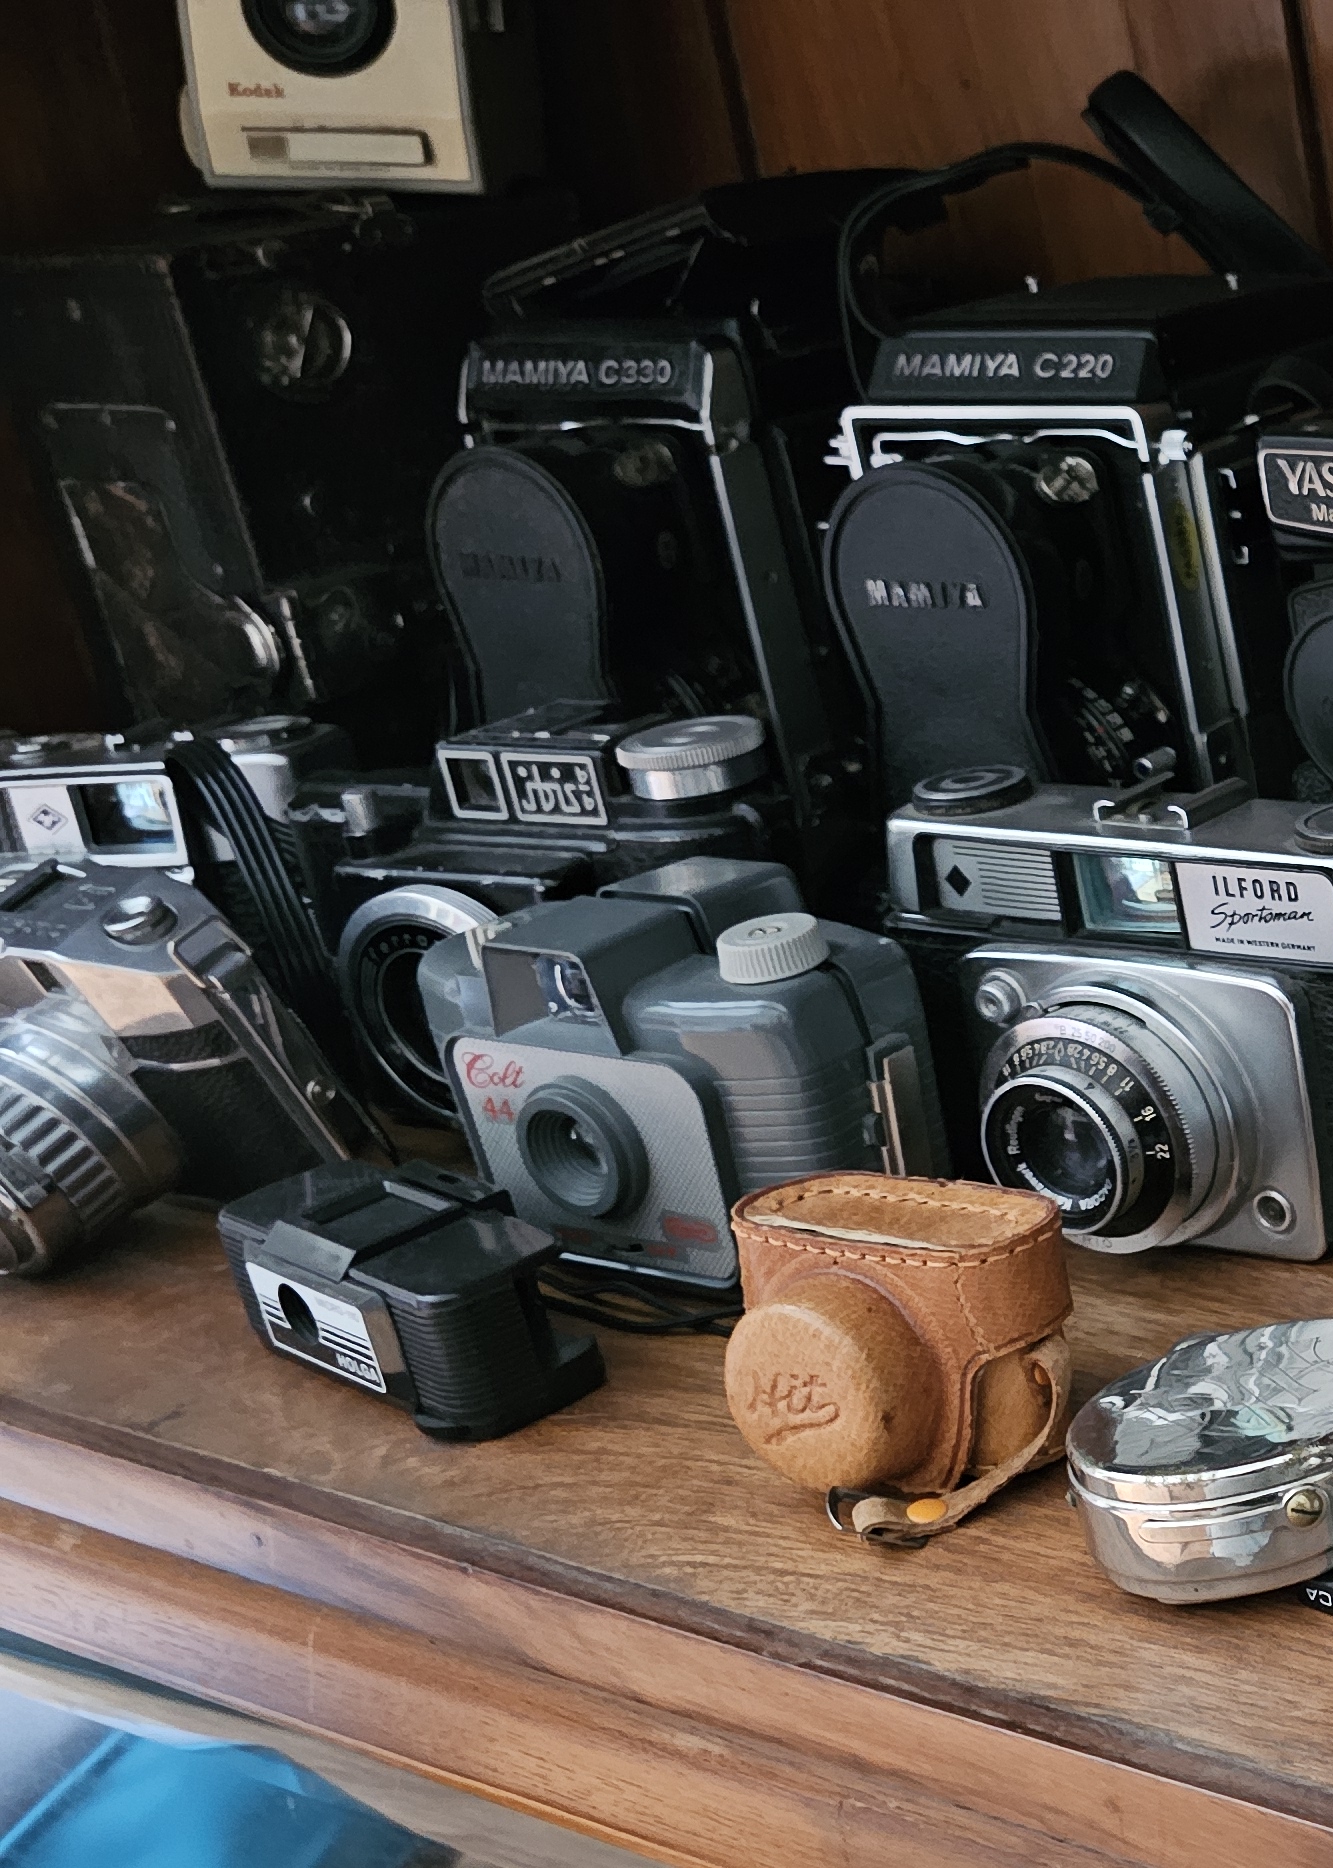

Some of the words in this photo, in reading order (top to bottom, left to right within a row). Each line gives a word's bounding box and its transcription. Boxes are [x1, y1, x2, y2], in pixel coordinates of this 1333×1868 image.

[227, 81, 285, 98] Kodak
[482, 359, 589, 385] MAMIYA
[598, 358, 672, 385] C330
[895, 353, 1020, 378] MAMIYA
[1033, 352, 1114, 379] C220
[865, 577, 987, 609] MAMIYA
[1211, 875, 1299, 902] ILFORD
[1215, 936, 1235, 944] MADE
[461, 1052, 526, 1089] Colt
[482, 1096, 515, 1122] 44
[1154, 1143, 1171, 1159] 22
[335, 1352, 381, 1384] HOLGA
